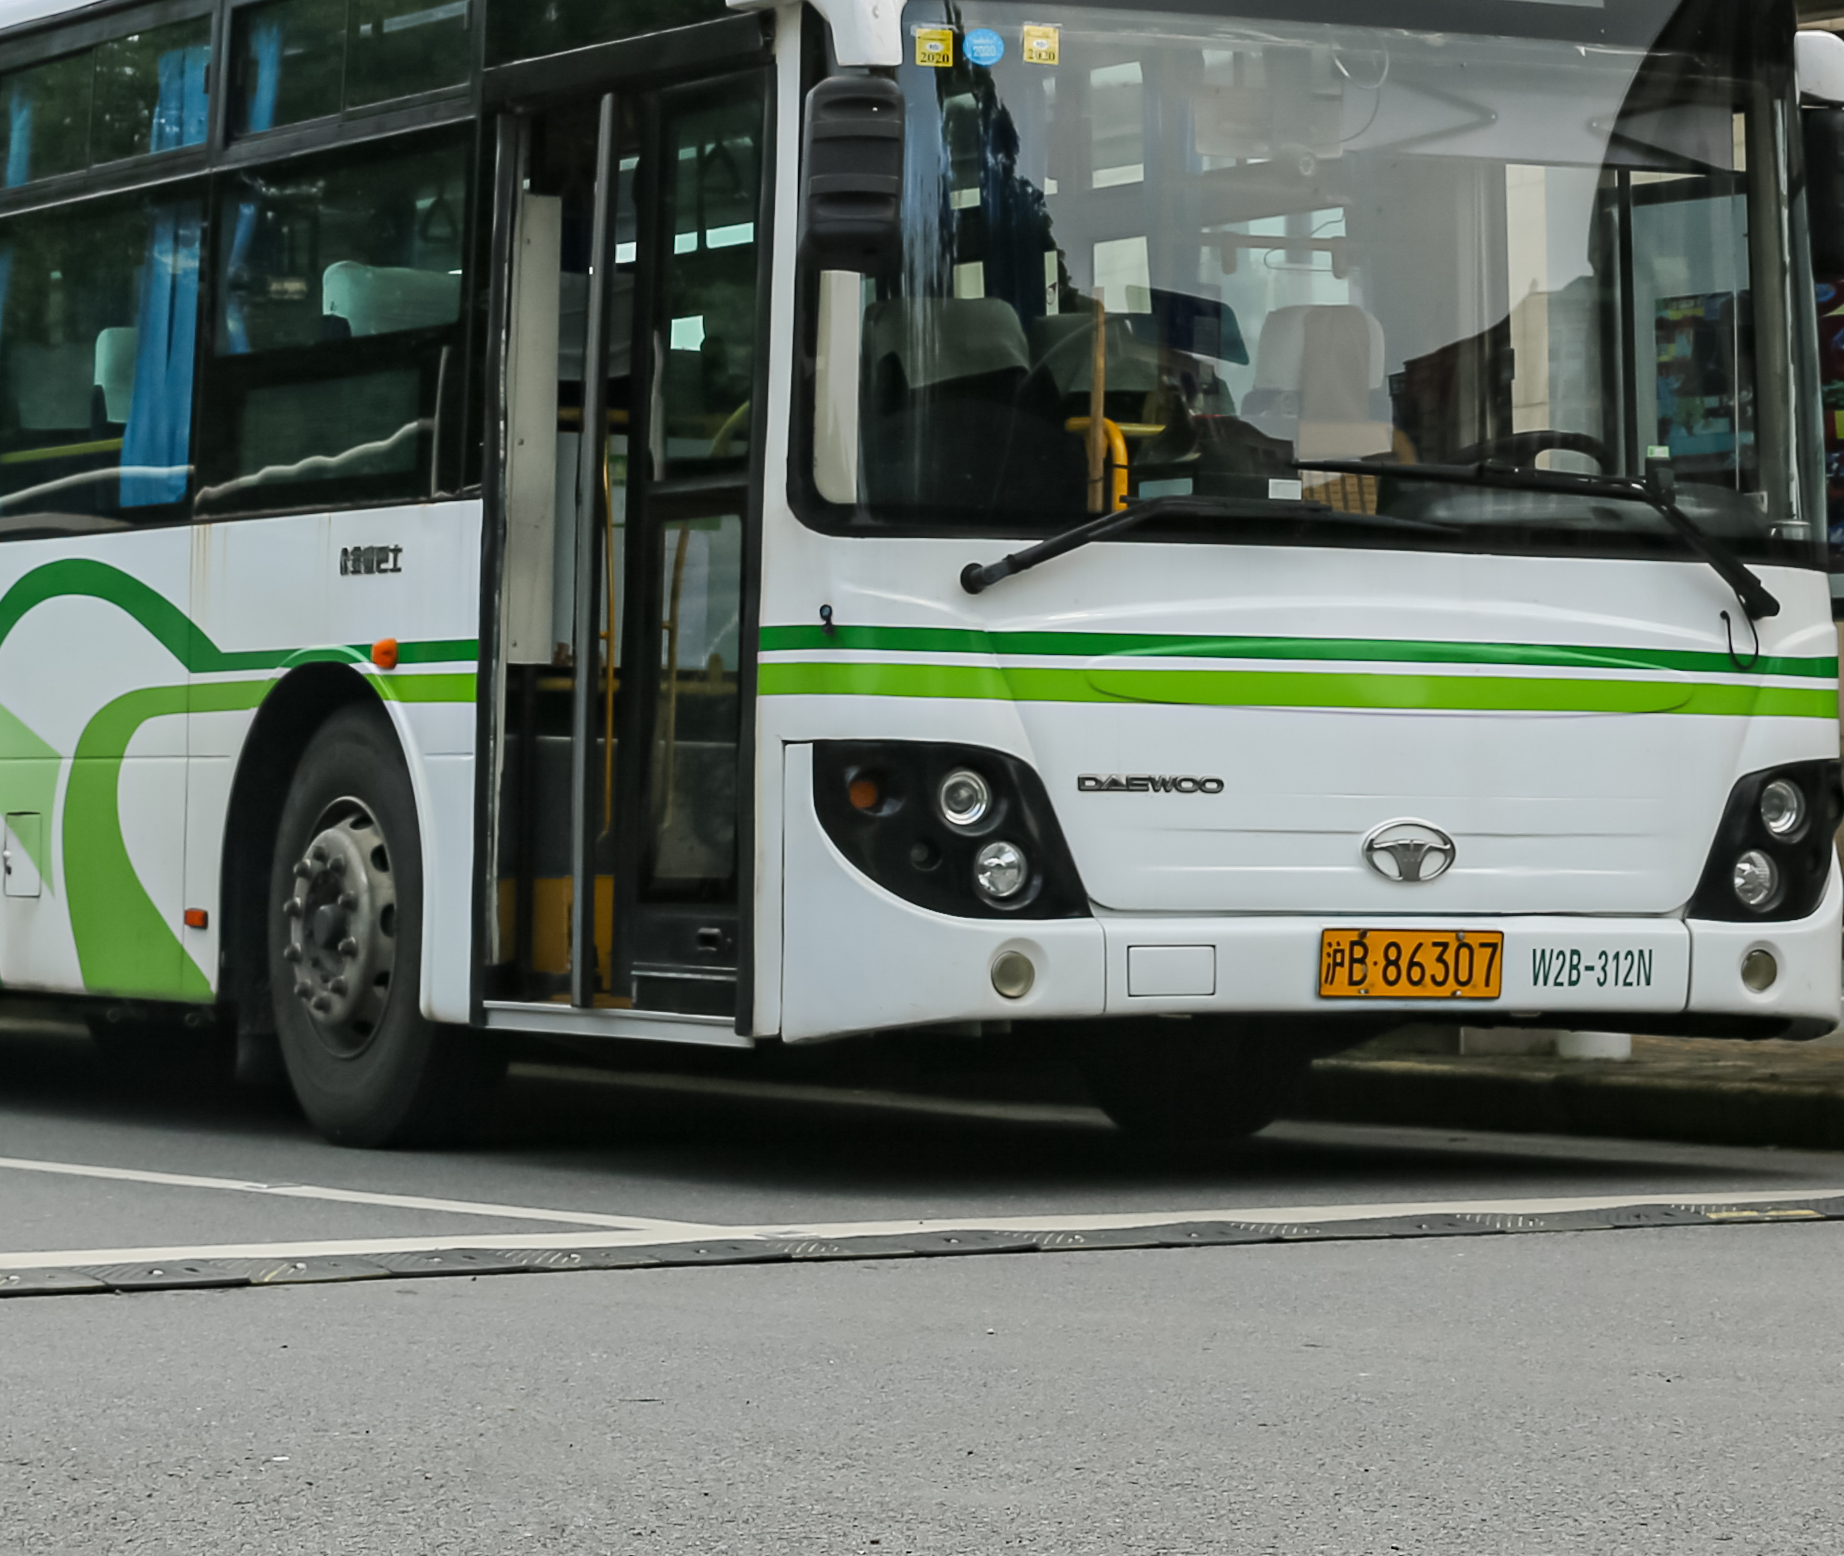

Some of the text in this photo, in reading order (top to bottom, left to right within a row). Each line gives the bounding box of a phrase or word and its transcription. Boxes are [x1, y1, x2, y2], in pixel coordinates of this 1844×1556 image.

[919, 52, 949, 64] 2020
[1077, 774, 1225, 794] DAEWOO
[1531, 948, 1654, 988] W2B-312N
